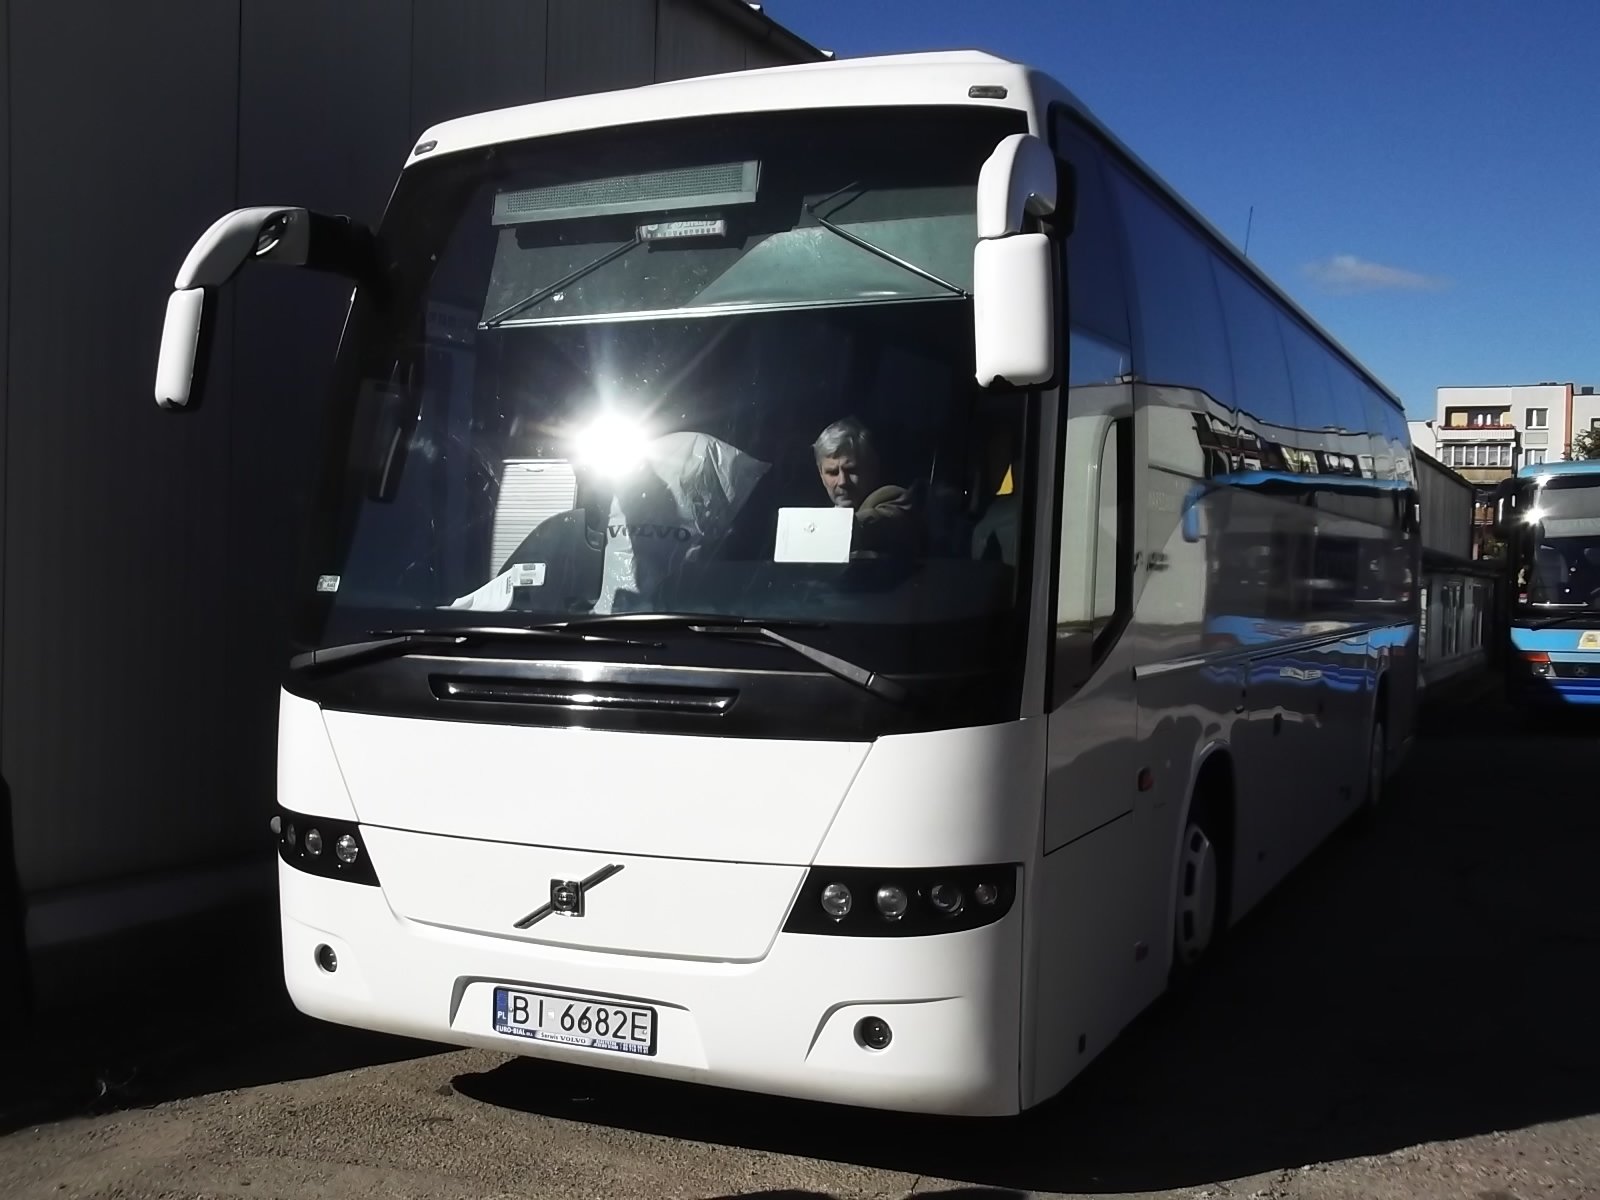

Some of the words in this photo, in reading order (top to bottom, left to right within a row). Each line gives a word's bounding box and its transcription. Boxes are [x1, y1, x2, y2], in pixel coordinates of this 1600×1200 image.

[607, 524, 691, 542] VOLVO
[497, 1011, 507, 1020] PL
[513, 994, 544, 1028] BI
[560, 1003, 648, 1043] 6682E
[541, 1032, 559, 1041] Serwis
[560, 1035, 586, 1045] VOLVO
